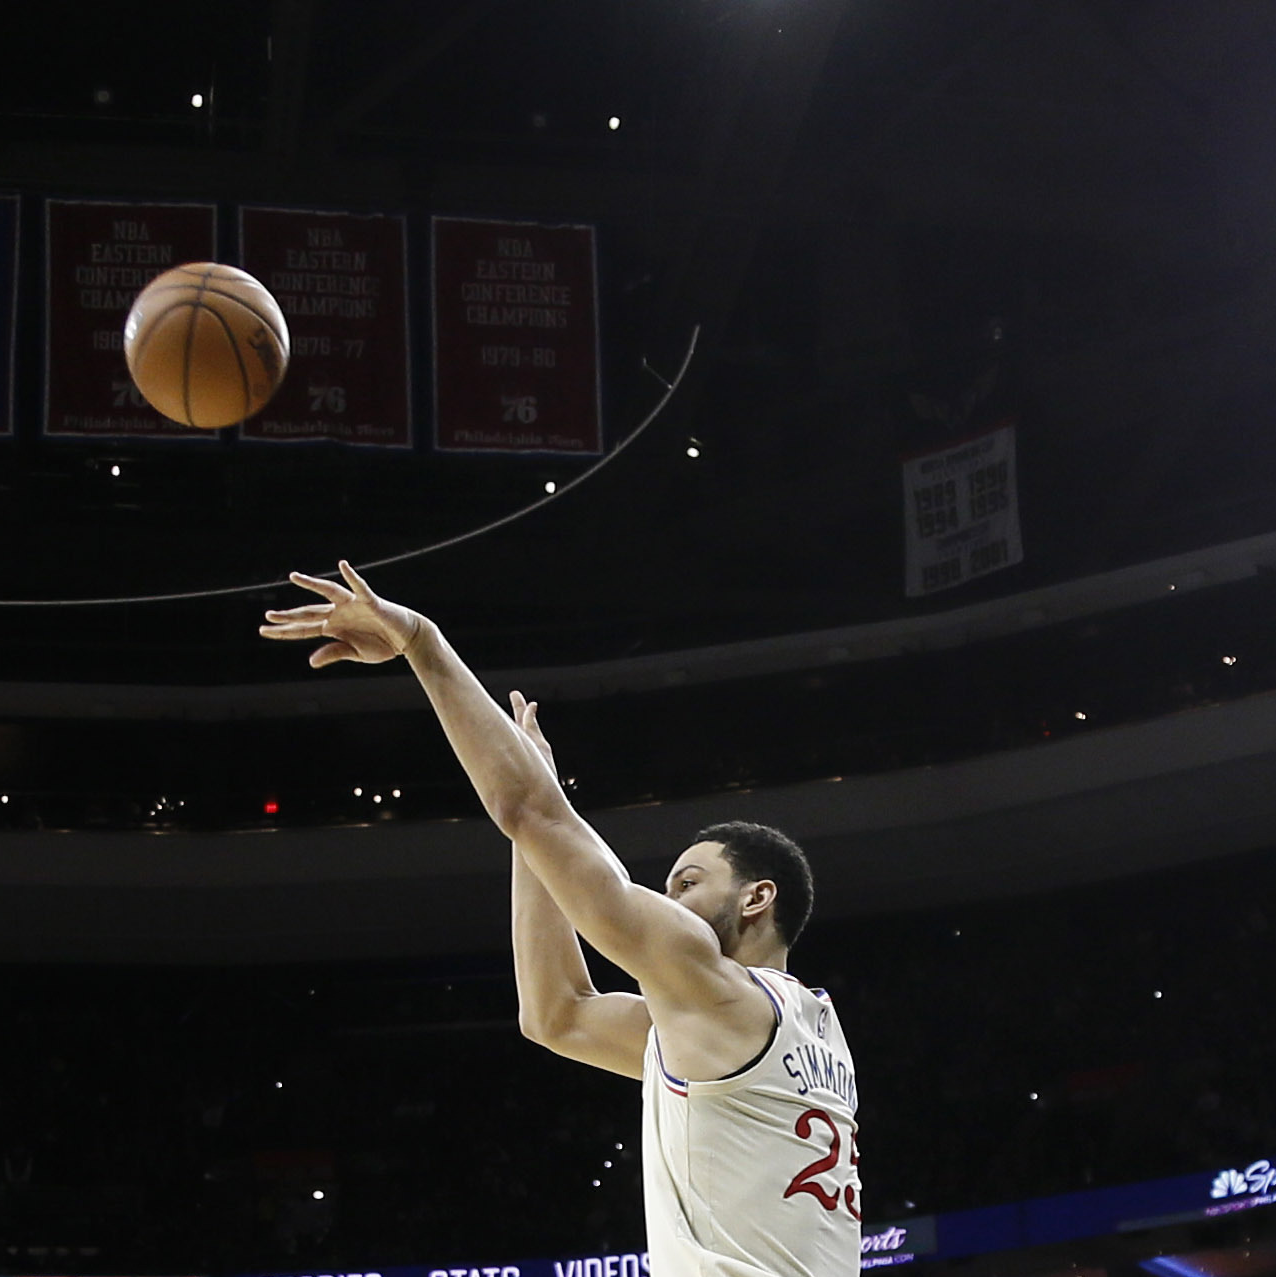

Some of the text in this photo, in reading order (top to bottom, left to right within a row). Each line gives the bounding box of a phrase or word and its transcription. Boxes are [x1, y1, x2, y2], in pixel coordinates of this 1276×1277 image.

[90, 243, 172, 264] EASTERN
[286, 249, 367, 271] EASTERN
[477, 261, 555, 282] EASTERN
[461, 284, 571, 305] CONFERENCE
[467, 308, 568, 328] CHAMPIONS
